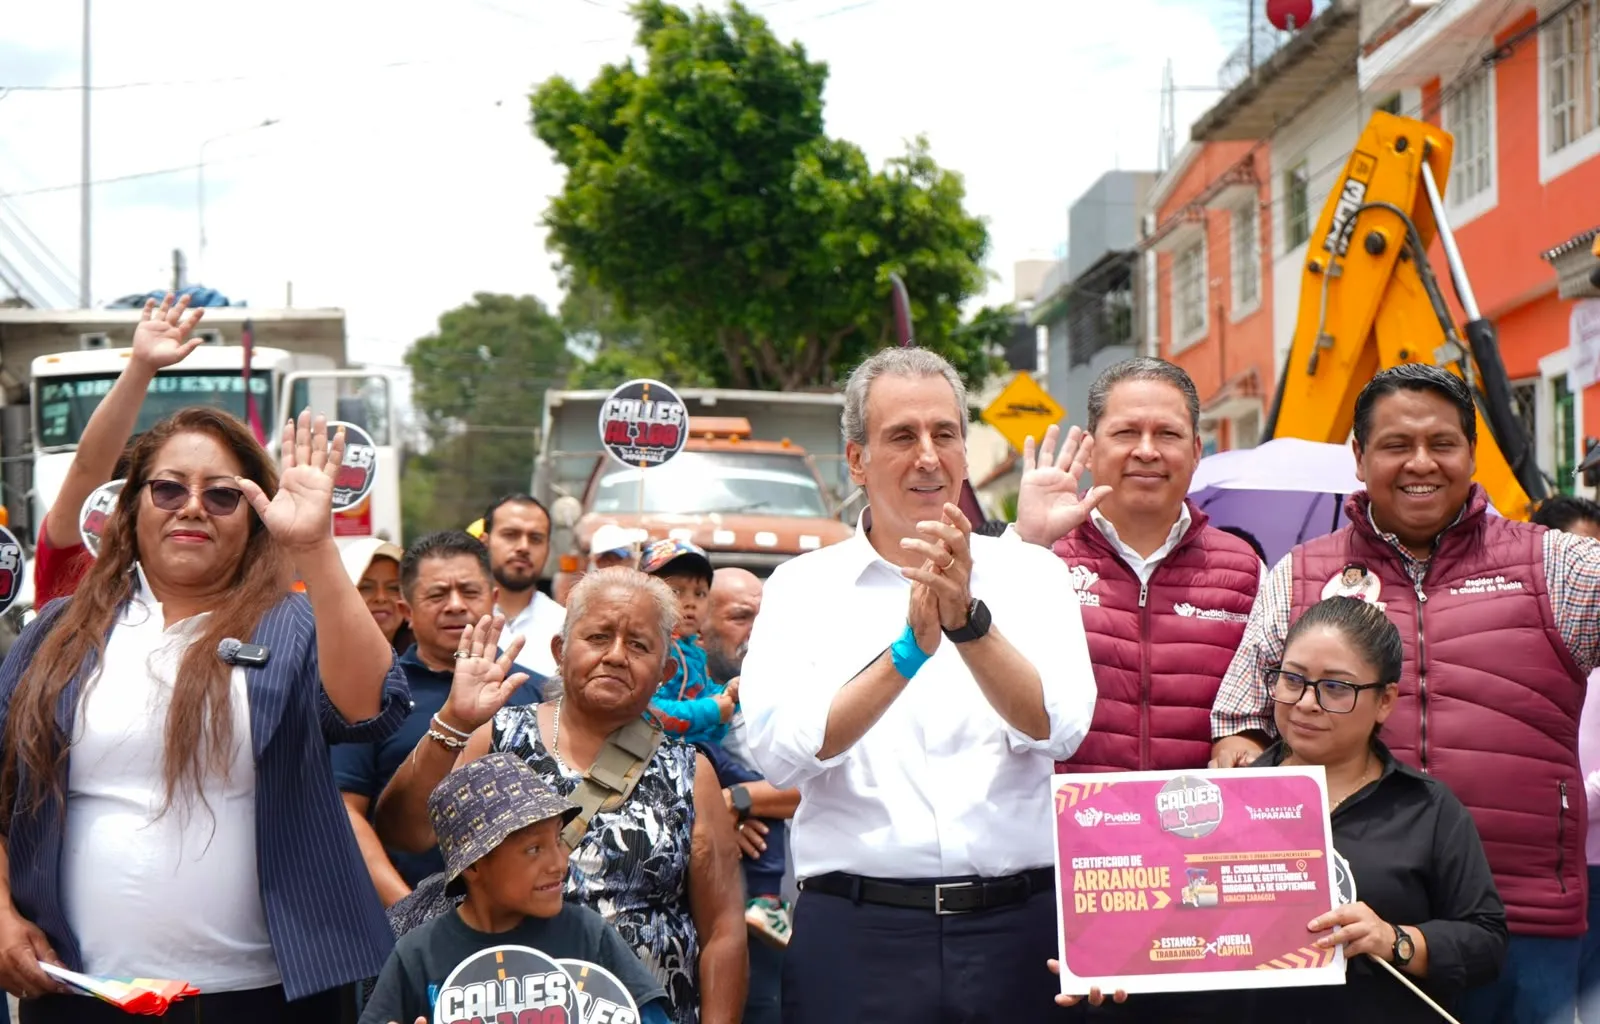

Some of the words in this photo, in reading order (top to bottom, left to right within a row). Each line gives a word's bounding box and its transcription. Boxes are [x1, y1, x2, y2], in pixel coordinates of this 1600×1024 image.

[42, 379, 117, 401] PADR
[604, 398, 684, 424] CALLES
[1450, 587, 1458, 595] la
[1459, 585, 1486, 594] Ciudad
[1487, 584, 1496, 592] de
[1497, 581, 1522, 591] Puebla
[1465, 577, 1493, 587] Regidor
[1495, 575, 1505, 583] de
[1157, 784, 1220, 812] CALLES
[1250, 811, 1302, 820] IMPARABLE
[1071, 855, 1130, 869] CERTIFICADO
[1130, 854, 1143, 867] DE
[1073, 866, 1171, 892] ARRANQUE
[1221, 874, 1242, 884] CALLE
[1252, 874, 1262, 883] DE
[1262, 872, 1303, 882] SEPTIEMBRE
[1265, 882, 1275, 892] DE
[1275, 881, 1316, 891] SEPTIEMBRE
[1074, 891, 1098, 914] DE
[1100, 889, 1149, 912] OBRA
[1246, 893, 1276, 902] ZARAGOZA
[1161, 936, 1197, 948] ESTAMOS
[1155, 949, 1201, 959] TRABAJANDO
[441, 970, 568, 1023] CALLES
